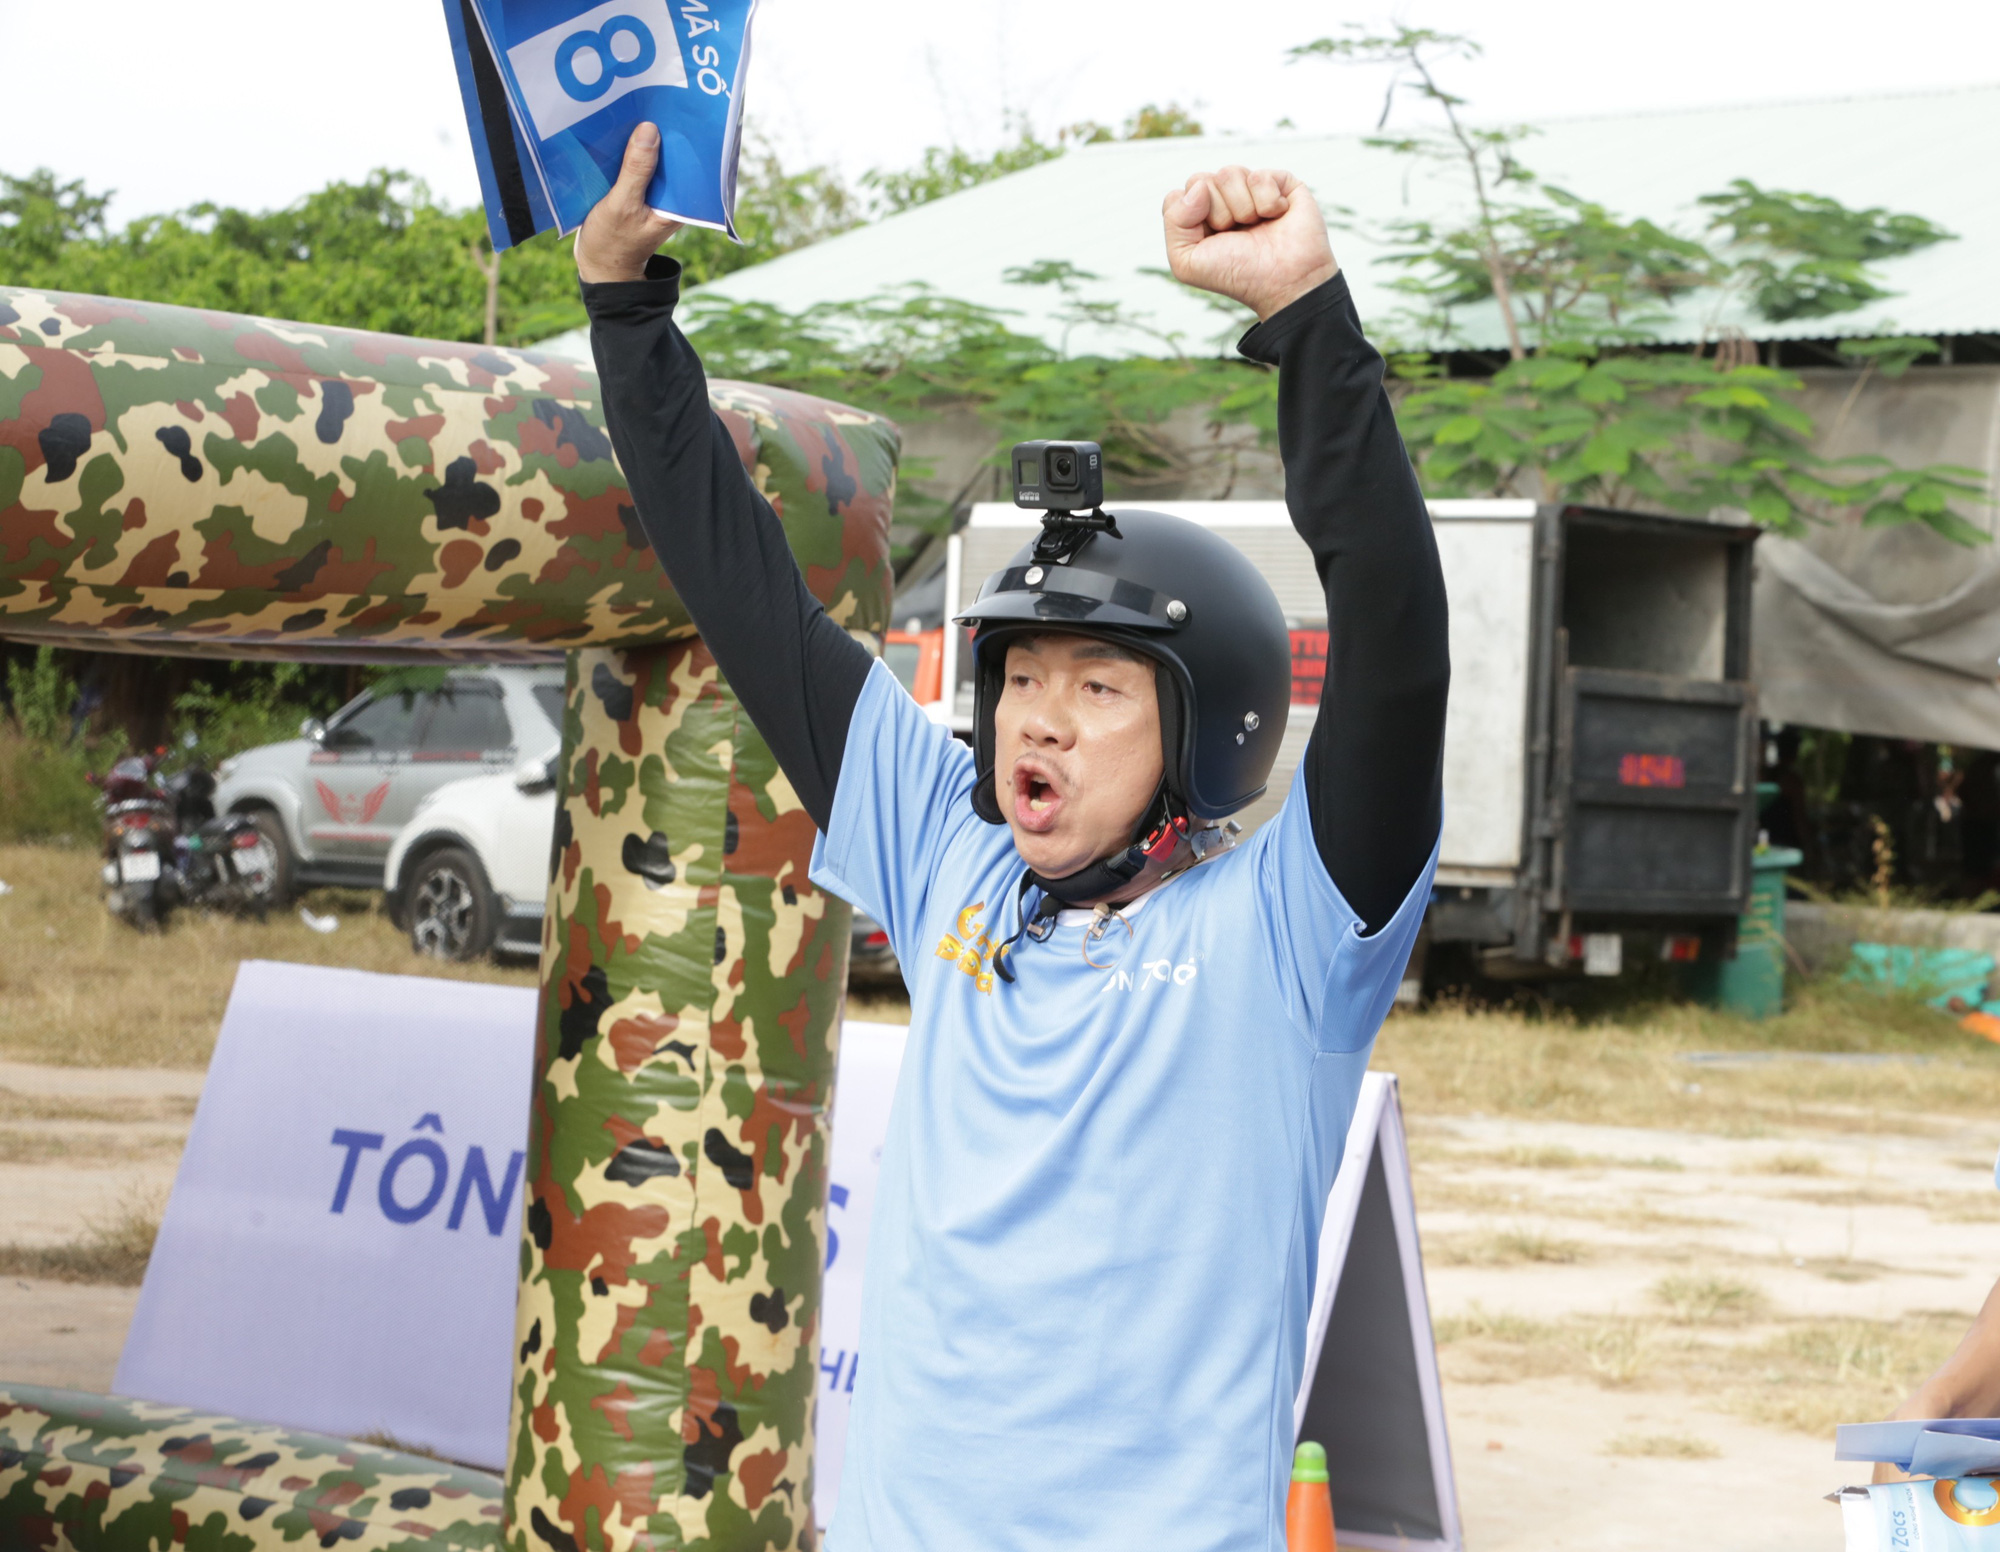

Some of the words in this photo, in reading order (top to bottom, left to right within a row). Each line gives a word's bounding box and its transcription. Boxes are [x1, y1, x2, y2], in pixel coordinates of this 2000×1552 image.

[554, 14, 656, 102] 8
[691, 44, 732, 99] SỐ
[330, 1111, 526, 1237] TÔN
[1891, 1510, 1909, 1547] Zacs
